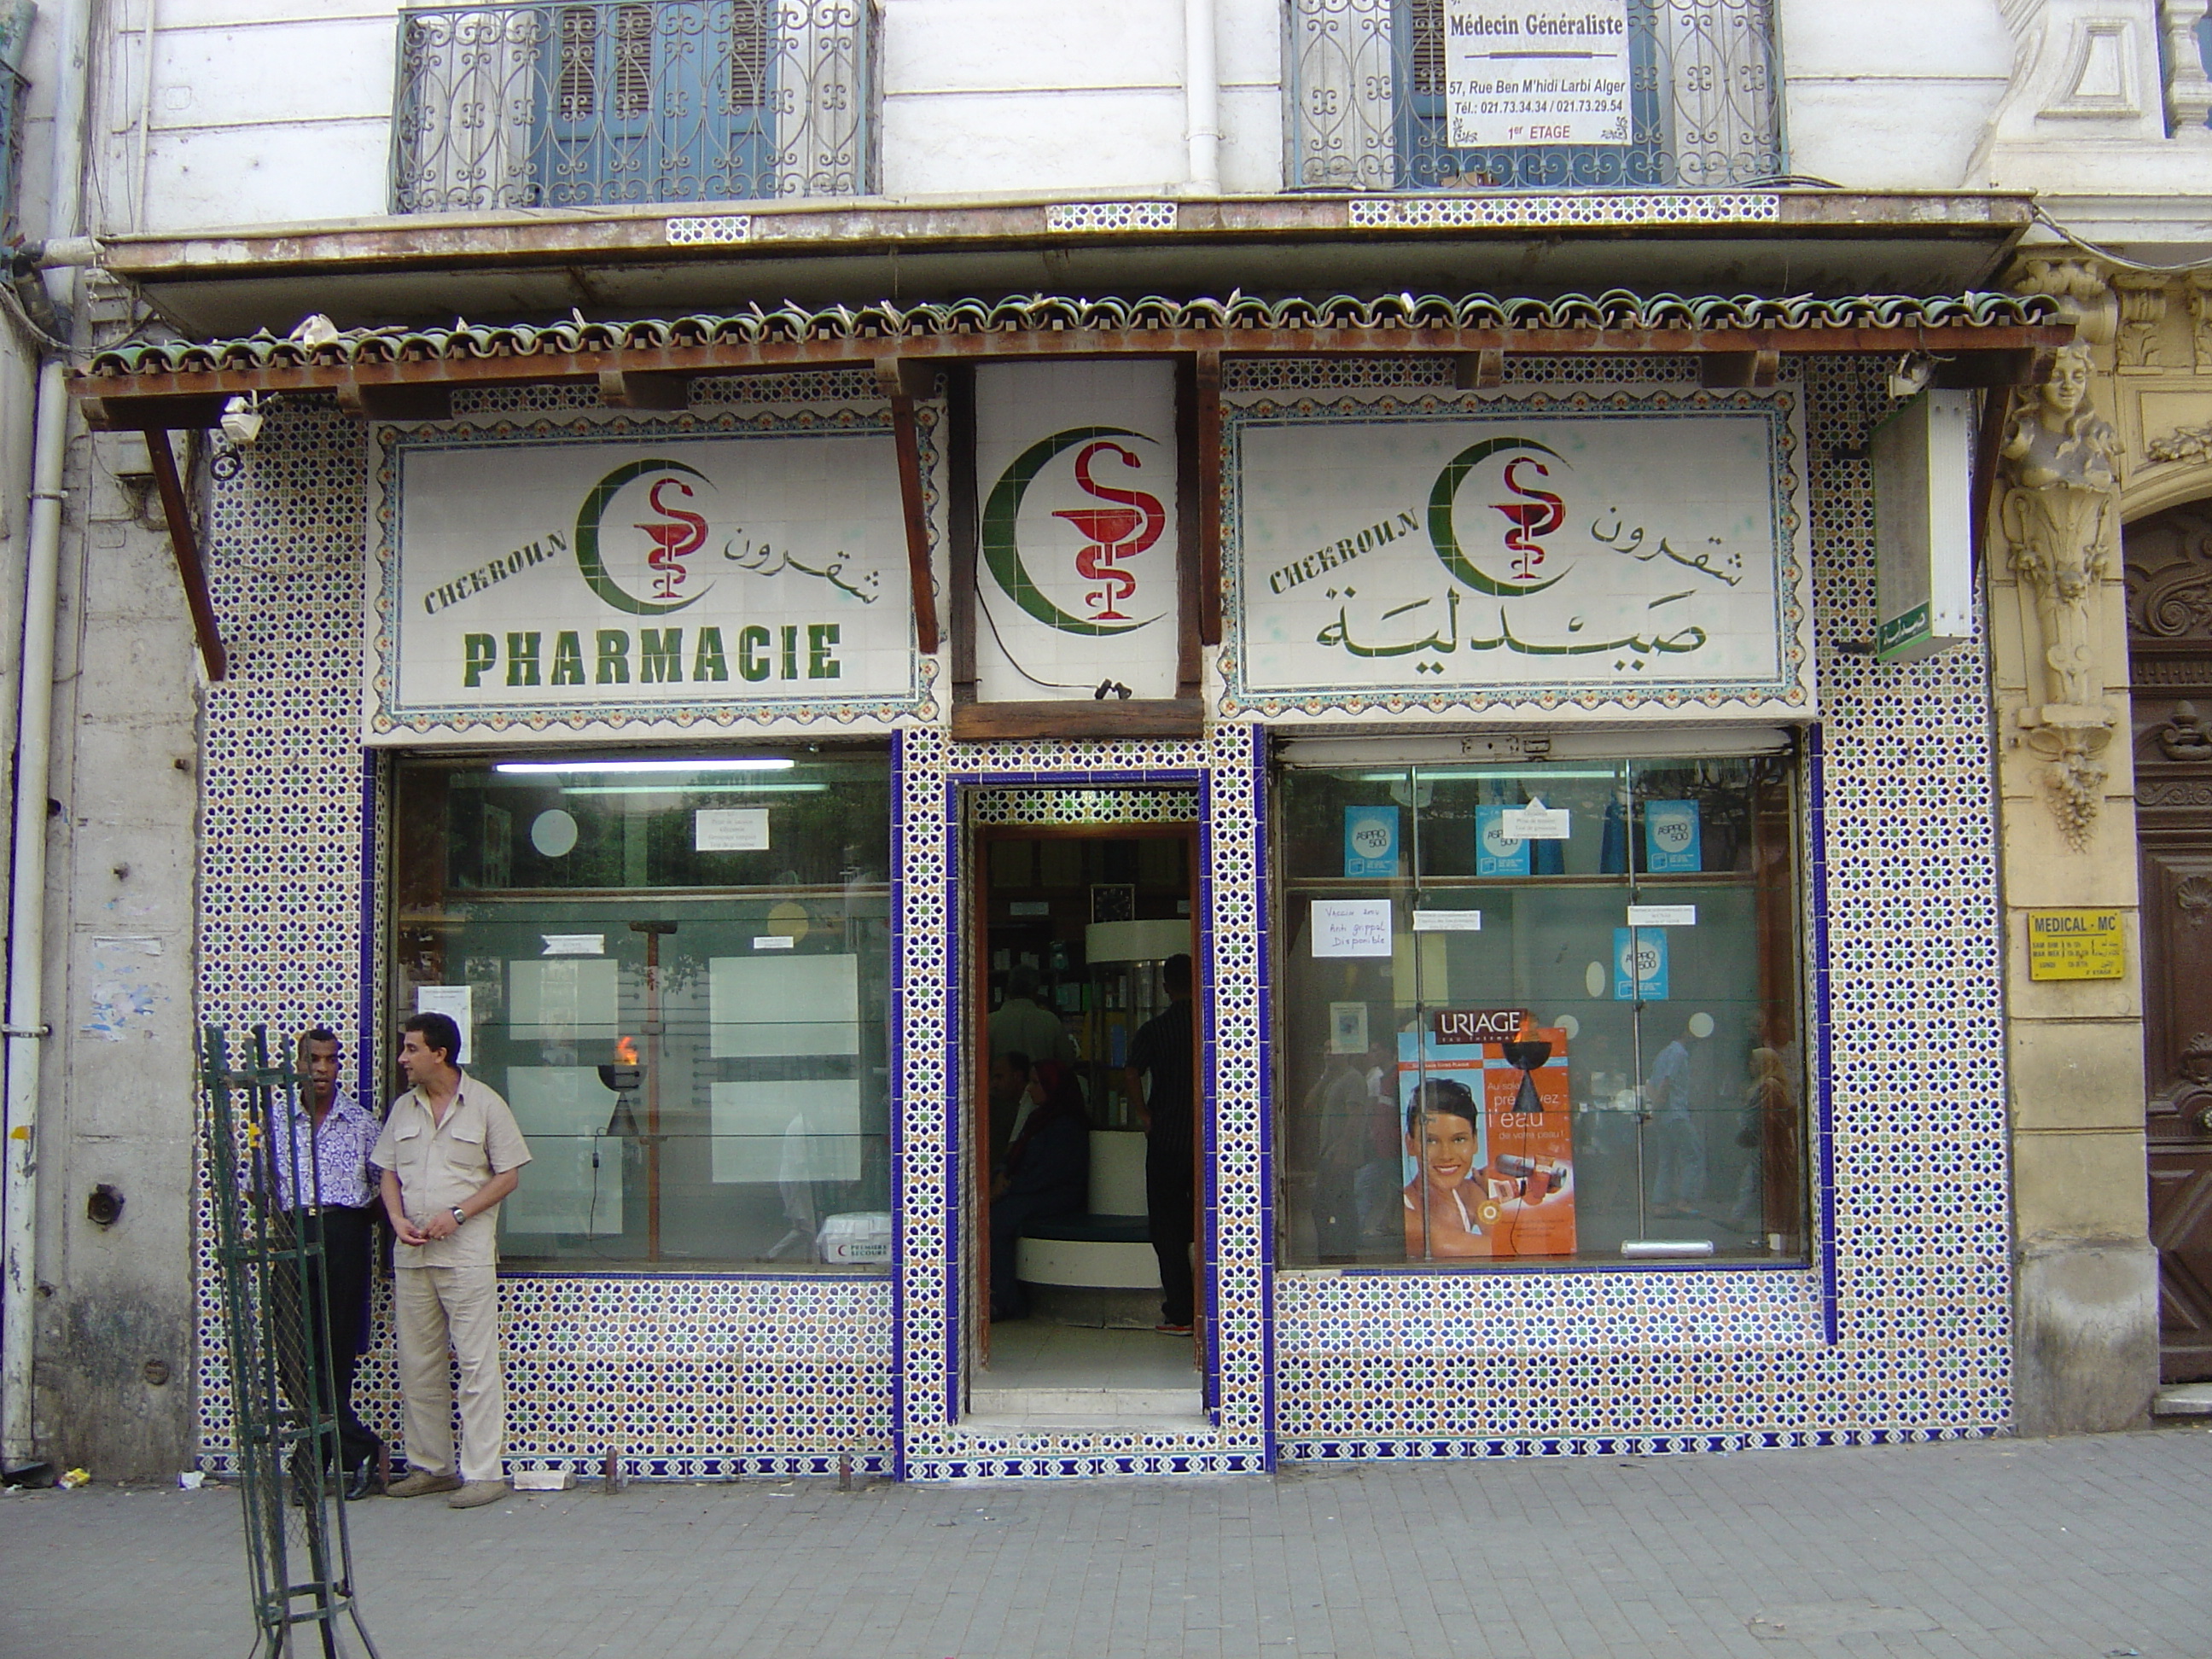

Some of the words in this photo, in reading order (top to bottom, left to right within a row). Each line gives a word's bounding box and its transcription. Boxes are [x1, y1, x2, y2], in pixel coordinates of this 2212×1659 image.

[1451, 14, 1519, 37] Médecin
[1526, 14, 1623, 36] Généraliste
[1449, 82, 1465, 96] 57,
[1470, 81, 1492, 95] Rue
[1496, 80, 1518, 94] Ben
[1522, 79, 1557, 93] M'hidi
[1561, 79, 1591, 93] Larbi
[1594, 79, 1625, 96] Alger
[1481, 101, 1547, 114] 021.73.34.34
[1557, 100, 1622, 113] 021.73.29.54
[1530, 125, 1571, 139] ETAGE
[1268, 507, 1420, 595] CHEKROUN
[424, 530, 567, 614] CHEKROUN
[463, 623, 841, 687] PHARMACIE
[1487, 830, 1503, 840] ASP
[1658, 823, 1687, 835] ASPRO
[1671, 832, 1688, 842] 500
[1369, 838, 1387, 848] 500
[2034, 917, 2087, 932] MEDICAL
[2098, 916, 2116, 931] MC
[1441, 1011, 1521, 1036] URIAGE
